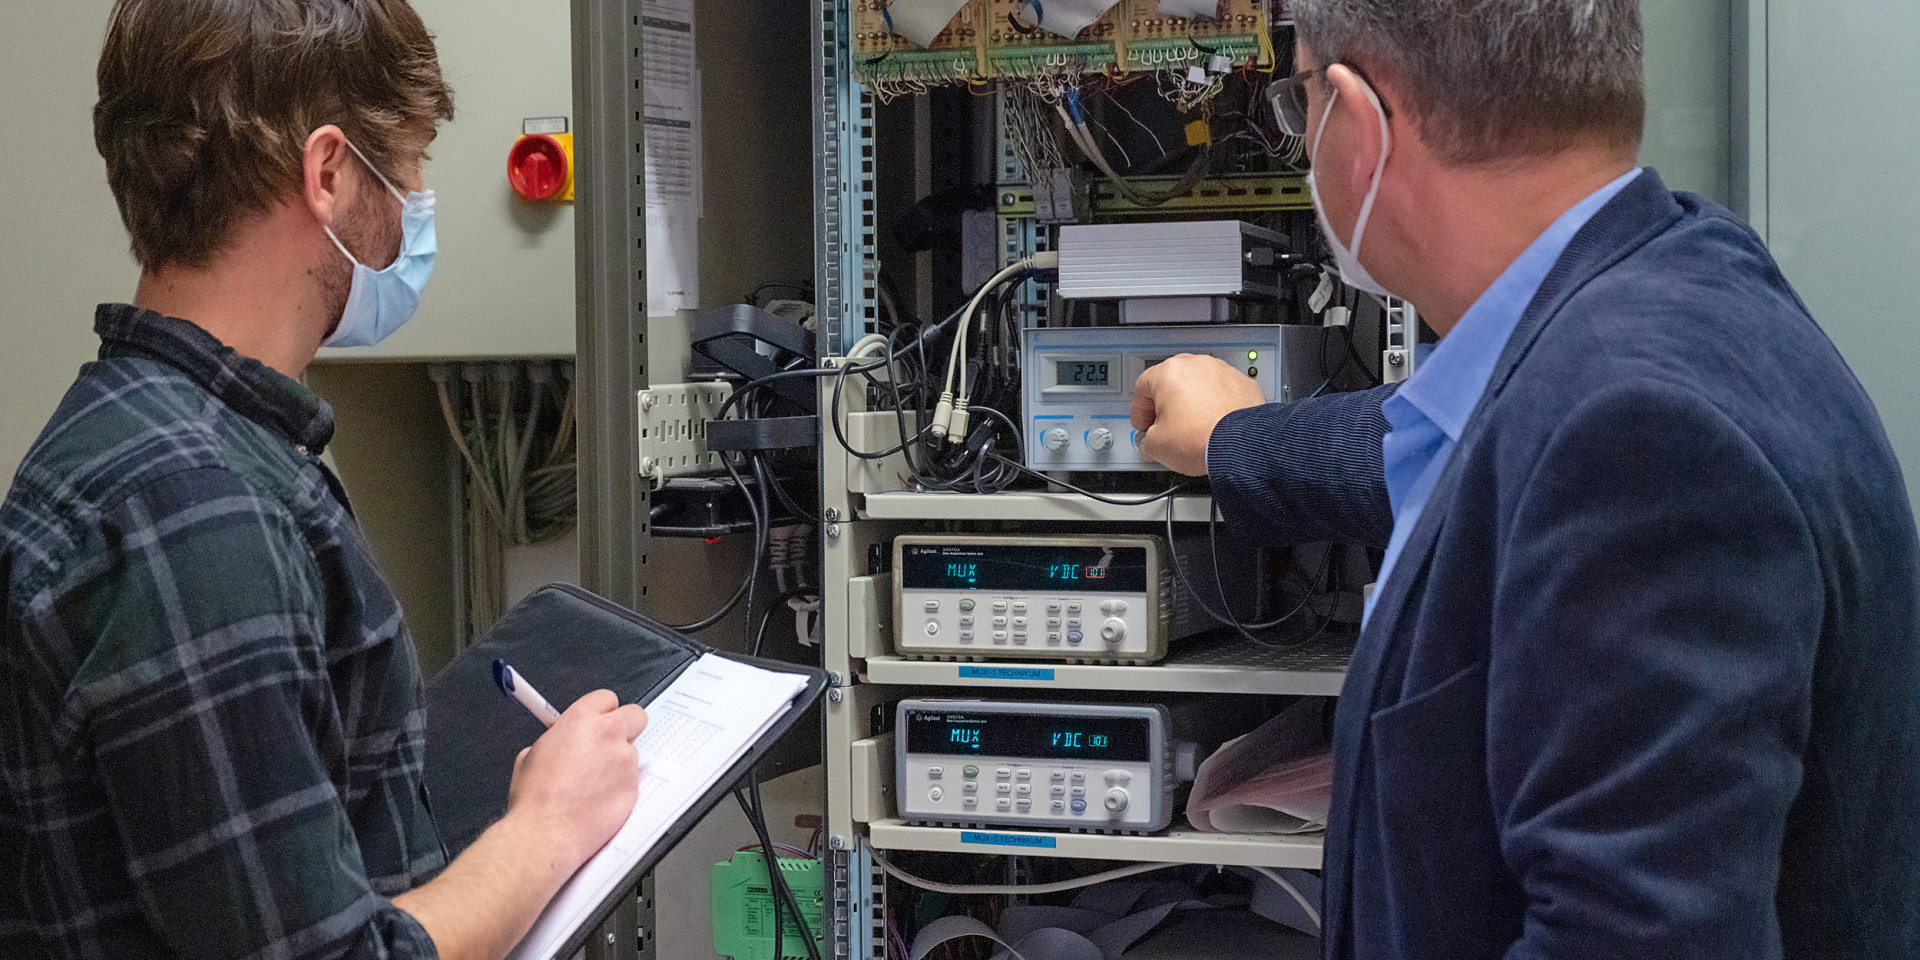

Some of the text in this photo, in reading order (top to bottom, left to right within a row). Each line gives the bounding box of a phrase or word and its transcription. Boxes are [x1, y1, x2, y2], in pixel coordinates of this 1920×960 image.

[1073, 364, 1108, 381] 22.9
[947, 563, 976, 577] MUX
[998, 669, 1041, 677] TECHNIKUM
[950, 728, 979, 743] MUX
[1093, 735, 1107, 746] 101
[974, 834, 1043, 844] MUX-2 TECHNIKUM
